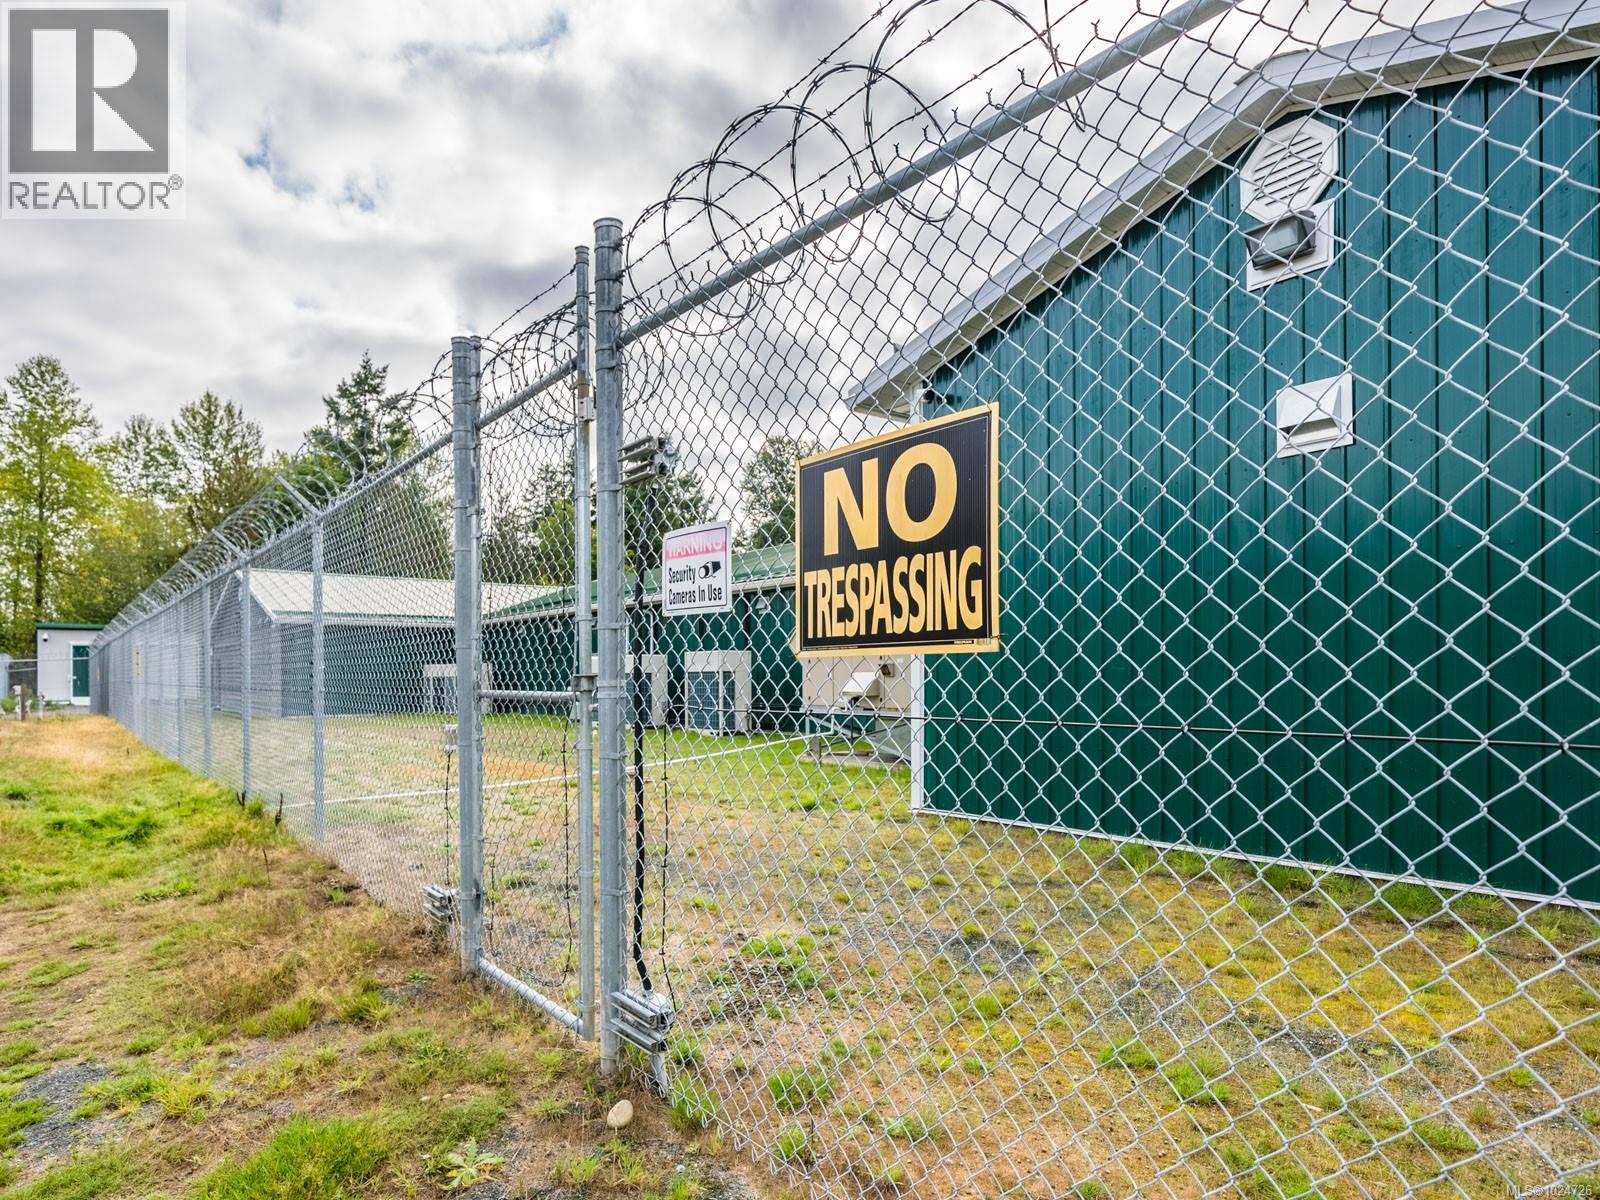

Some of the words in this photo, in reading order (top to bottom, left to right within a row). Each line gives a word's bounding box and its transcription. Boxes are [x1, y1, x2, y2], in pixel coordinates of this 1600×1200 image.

[823, 442, 958, 557] NO
[668, 534, 723, 556] WARNING
[668, 564, 696, 584] Security
[668, 588, 696, 605] Cameras
[698, 585, 706, 602] In
[707, 583, 722, 601] Use
[804, 545, 983, 639] TRESPASSING
